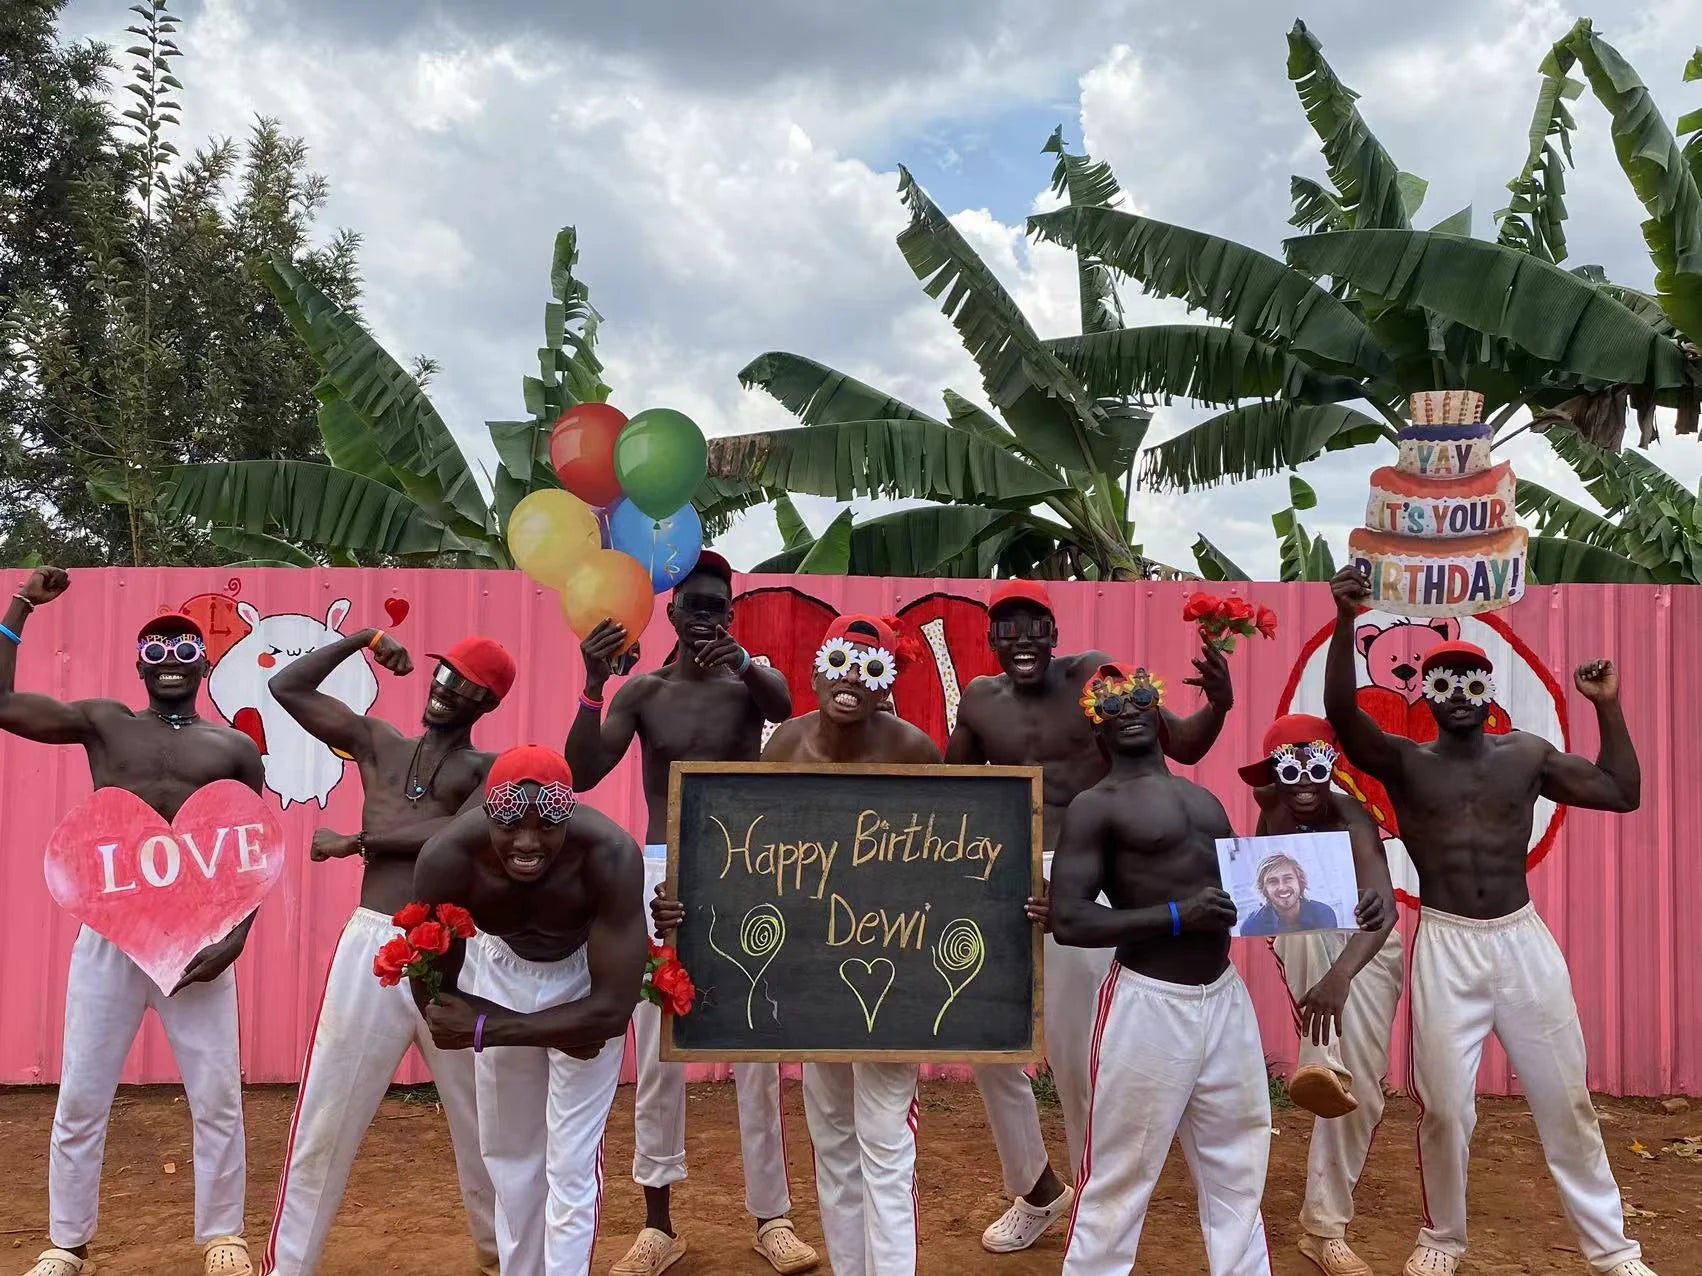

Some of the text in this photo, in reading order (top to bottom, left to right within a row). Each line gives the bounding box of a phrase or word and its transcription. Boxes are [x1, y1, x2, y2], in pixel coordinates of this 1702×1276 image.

[1416, 444, 1472, 475] YAY
[1378, 499, 1506, 534] IT'S YOUR
[96, 822, 268, 895] LOVE
[709, 808, 1003, 900] Happy Birthday
[825, 892, 932, 950] Dewi
